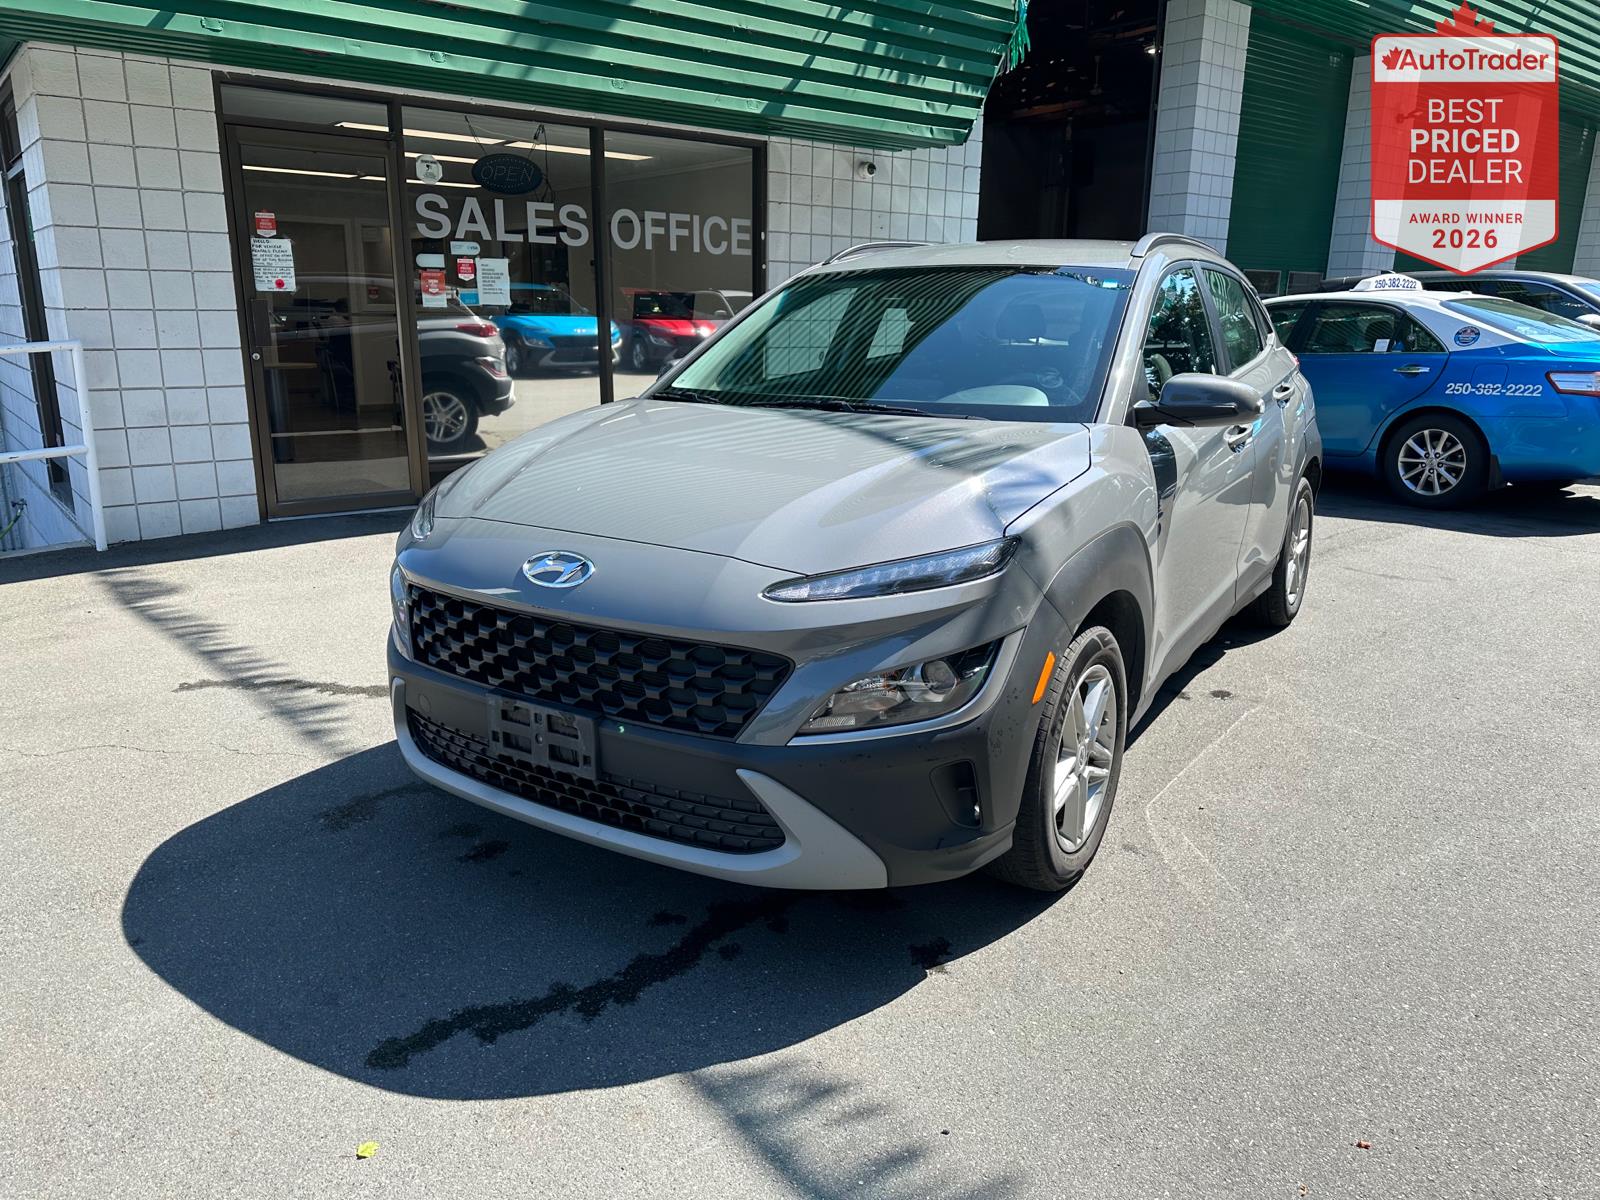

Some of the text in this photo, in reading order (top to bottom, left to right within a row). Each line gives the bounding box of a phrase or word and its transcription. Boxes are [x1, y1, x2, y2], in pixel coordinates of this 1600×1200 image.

[480, 165, 535, 182] OPEN
[415, 193, 752, 256] SALES OFFICE
[1374, 277, 1417, 289] 250-382-2222
[1445, 382, 1543, 397] 250-382-2222
